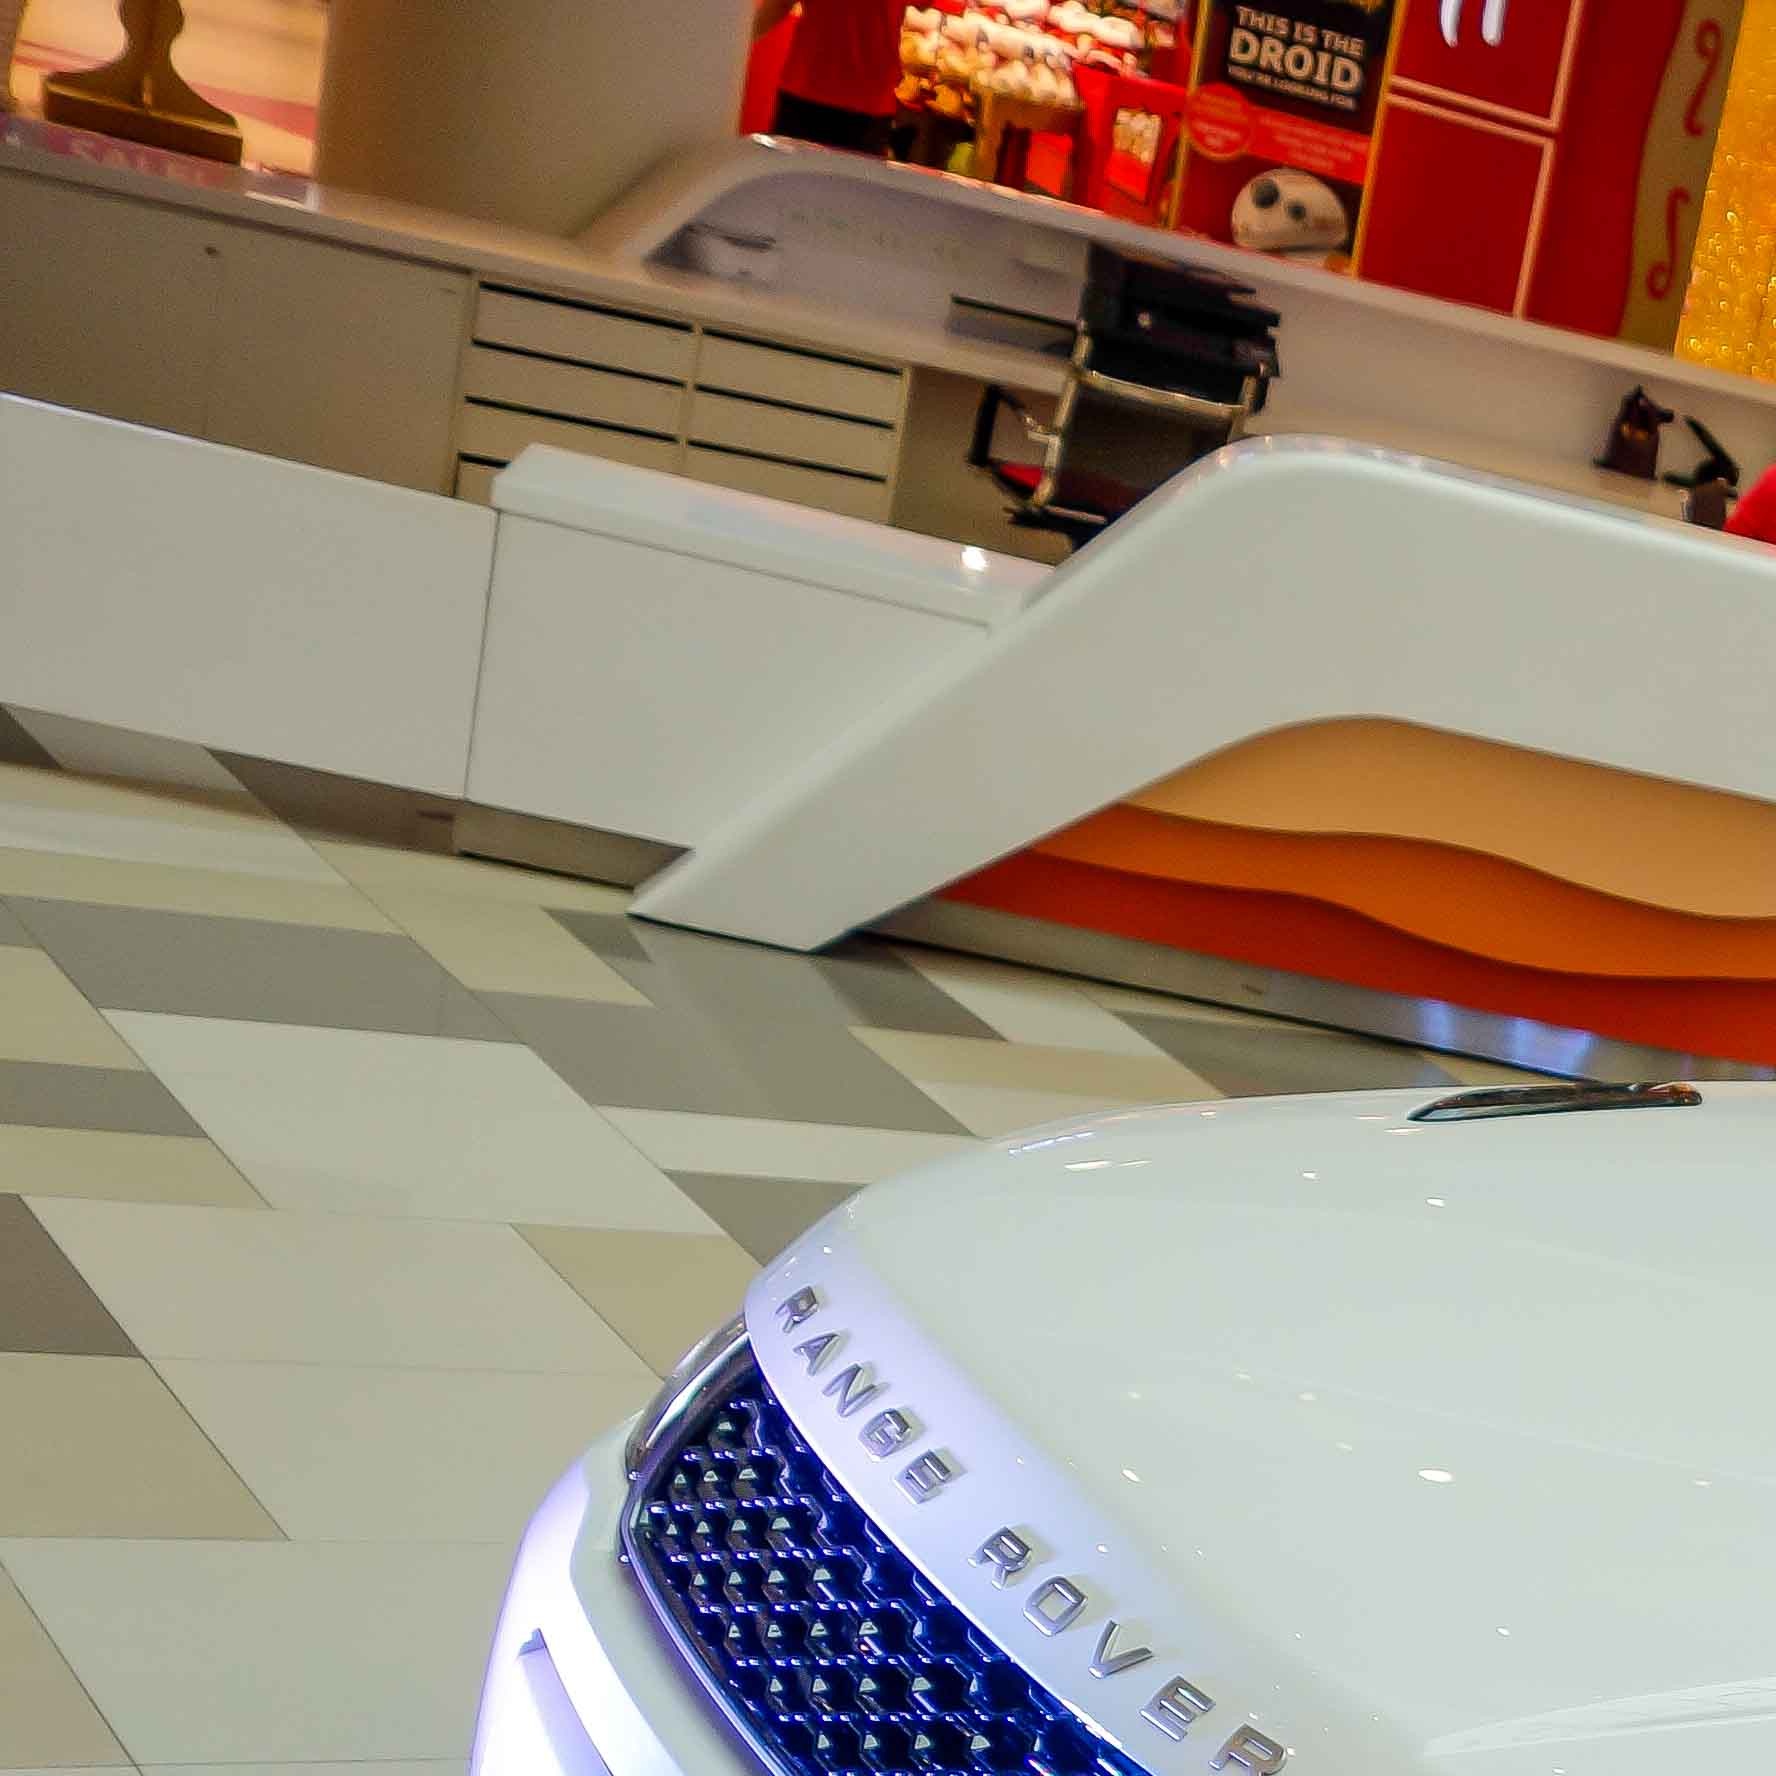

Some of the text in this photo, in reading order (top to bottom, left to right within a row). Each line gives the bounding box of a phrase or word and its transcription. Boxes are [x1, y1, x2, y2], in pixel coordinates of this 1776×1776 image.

[1228, 27, 1364, 92] DROID
[1235, 5, 1365, 57] THIS IS THE
[775, 1284, 952, 1506] RANGE
